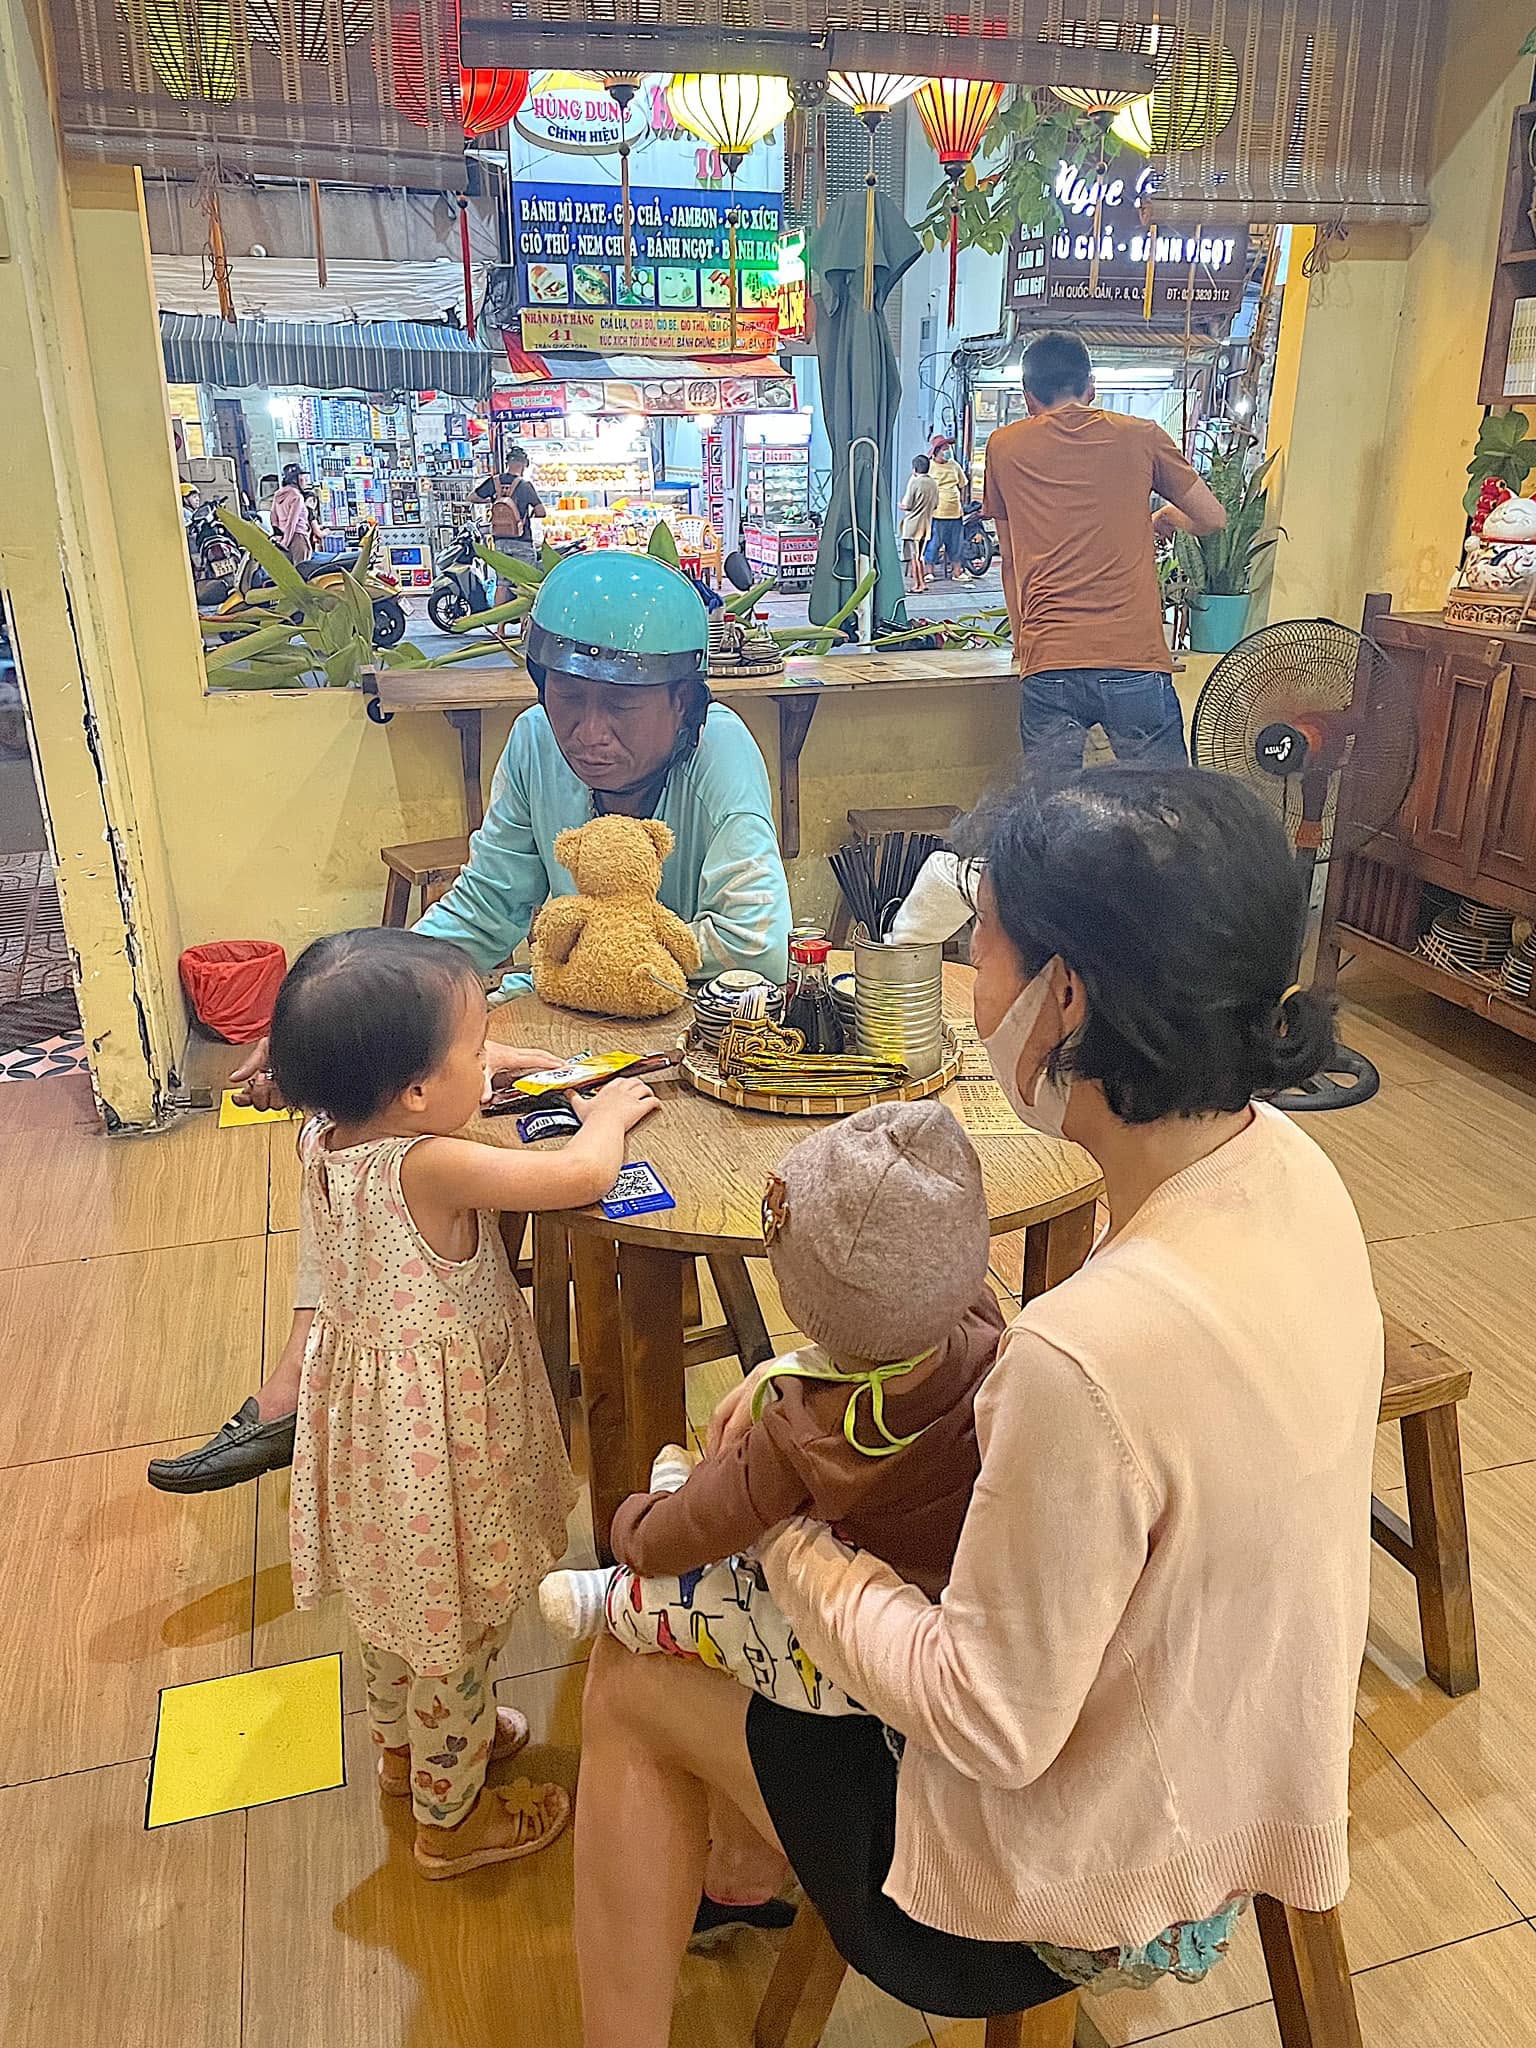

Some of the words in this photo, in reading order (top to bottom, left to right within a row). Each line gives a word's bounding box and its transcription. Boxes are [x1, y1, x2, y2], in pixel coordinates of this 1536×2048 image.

[589, 125, 619, 145] HIỆU
[520, 195, 556, 221] BÁNH
[558, 197, 572, 222] MÌ
[575, 203, 606, 224] PATE
[637, 197, 662, 227] CHẢ
[670, 206, 717, 229] JAMBON
[751, 205, 778, 231] XÍCH
[520, 228, 542, 254] GIÒ
[544, 225, 569, 254] THỦ
[577, 235, 604, 255] NEM
[647, 231, 680, 258] BÁNH
[682, 238, 714, 263] NGỌT
[548, 329, 572, 341] 41
